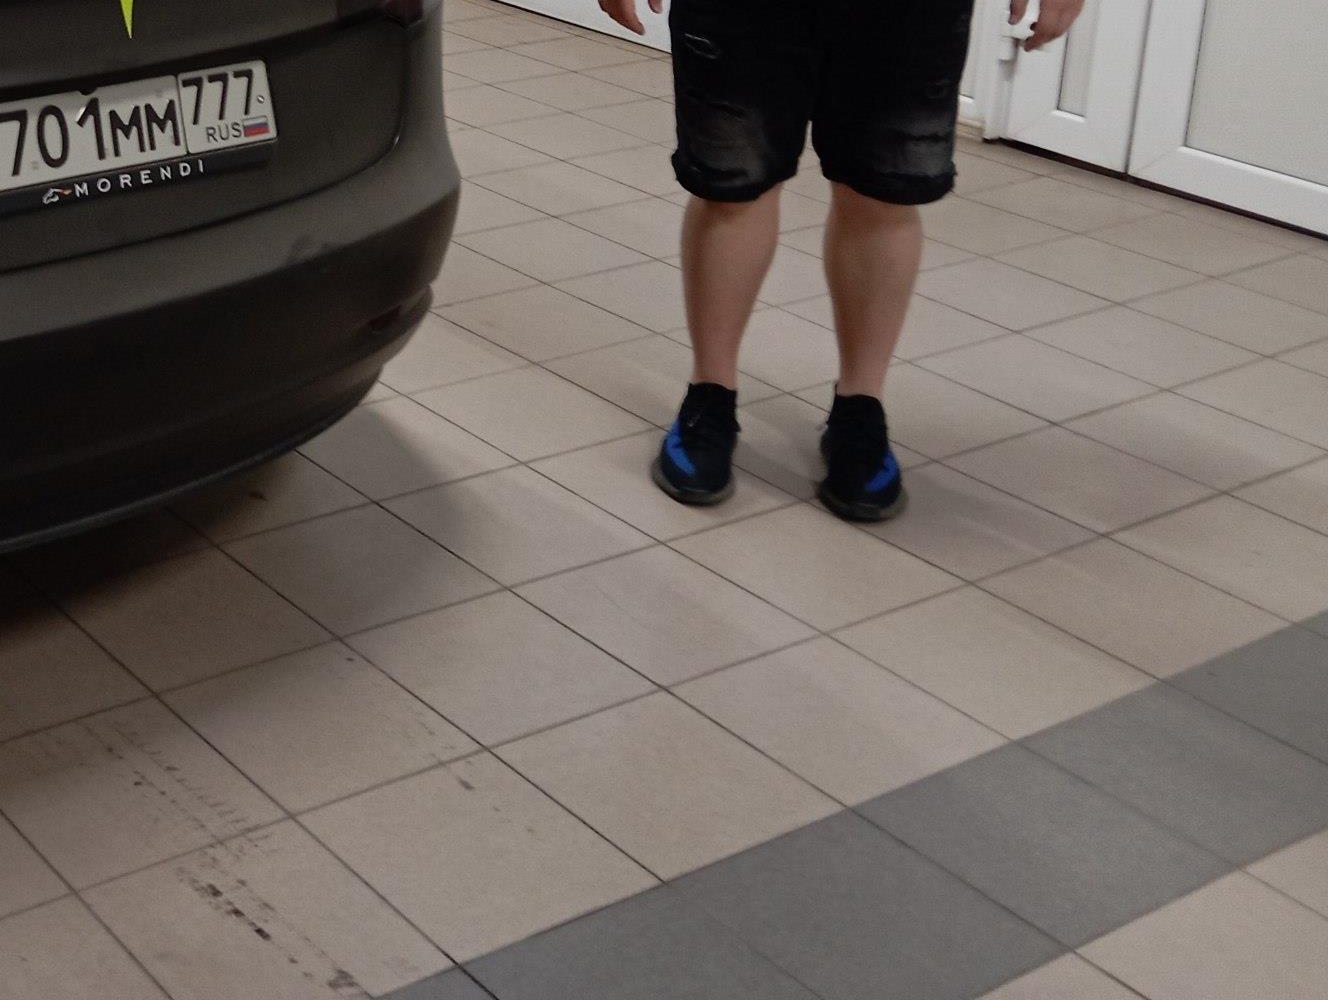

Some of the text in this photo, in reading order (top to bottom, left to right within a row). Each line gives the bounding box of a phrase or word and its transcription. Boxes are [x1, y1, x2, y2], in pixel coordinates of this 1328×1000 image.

[181, 67, 256, 126] 777
[205, 121, 242, 144] RUS
[73, 158, 205, 198] MORENDI
